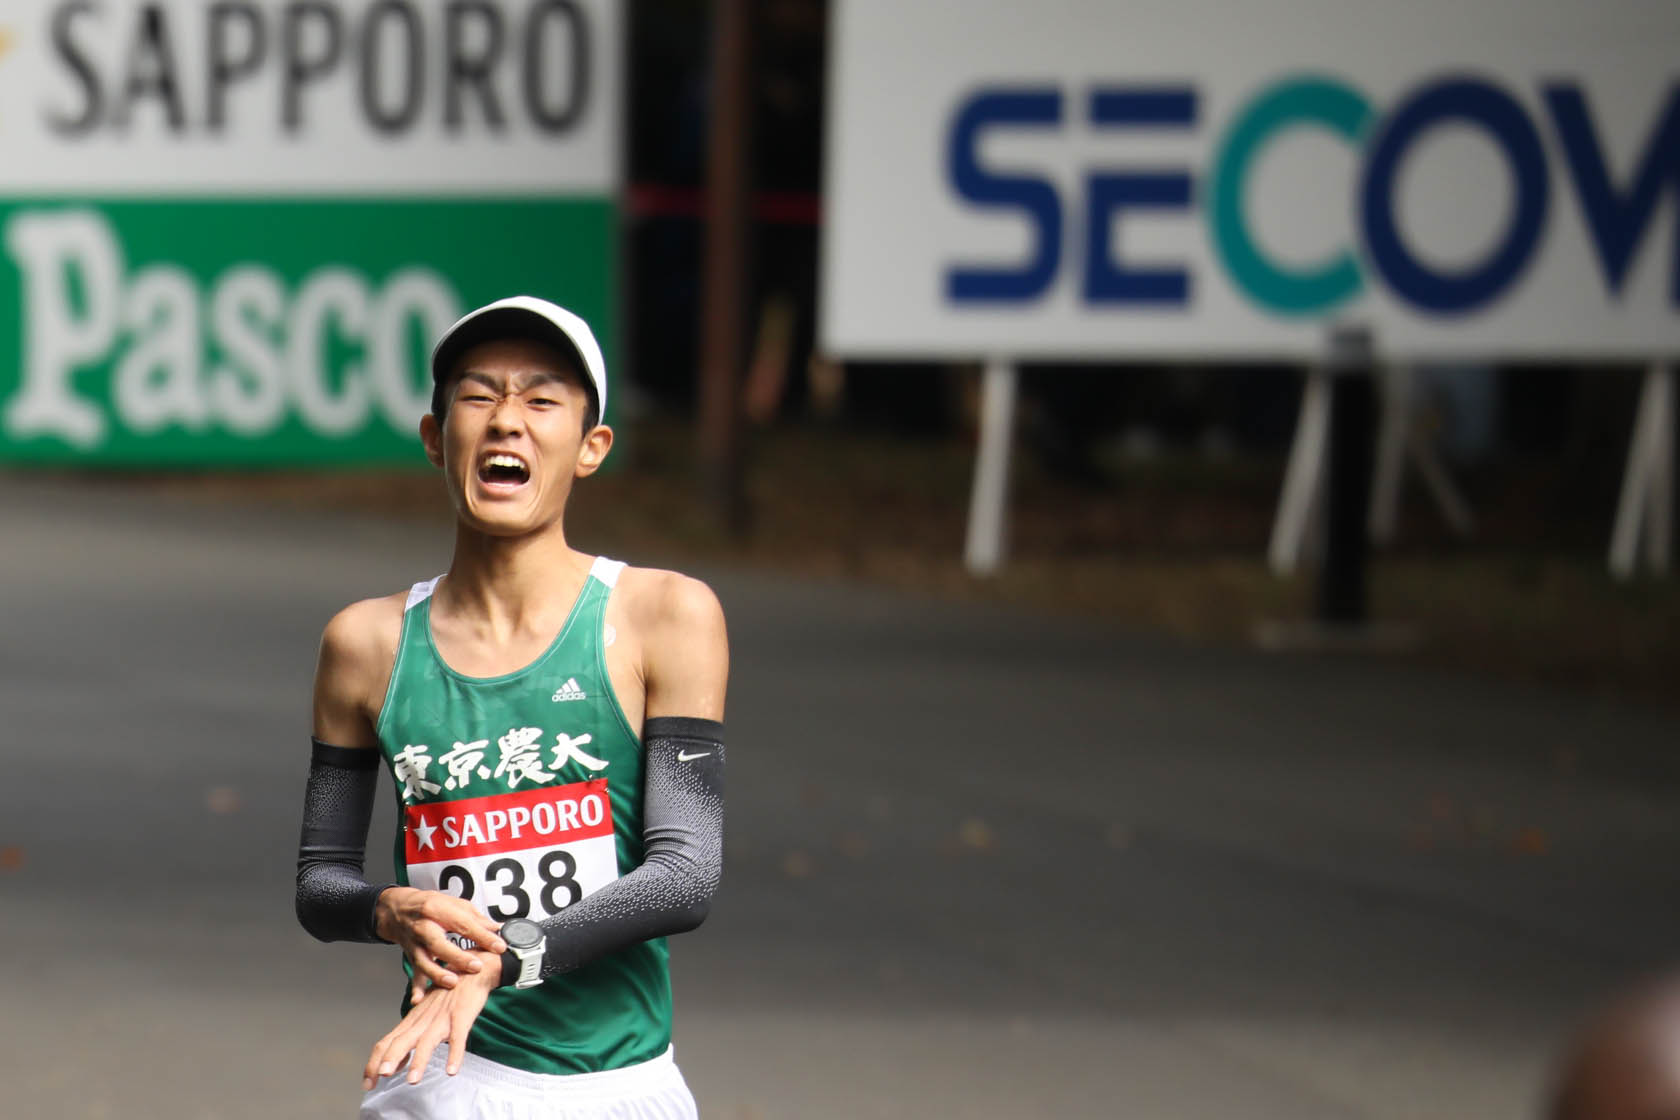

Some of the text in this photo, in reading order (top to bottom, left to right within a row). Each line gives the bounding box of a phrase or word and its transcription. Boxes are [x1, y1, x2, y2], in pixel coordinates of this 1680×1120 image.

[42, 0, 596, 142] SAPPORO
[2, 207, 463, 450] Pasco
[551, 691, 587, 702] adidas
[394, 727, 610, 800] 東京農大
[442, 794, 604, 848] SAPPORO
